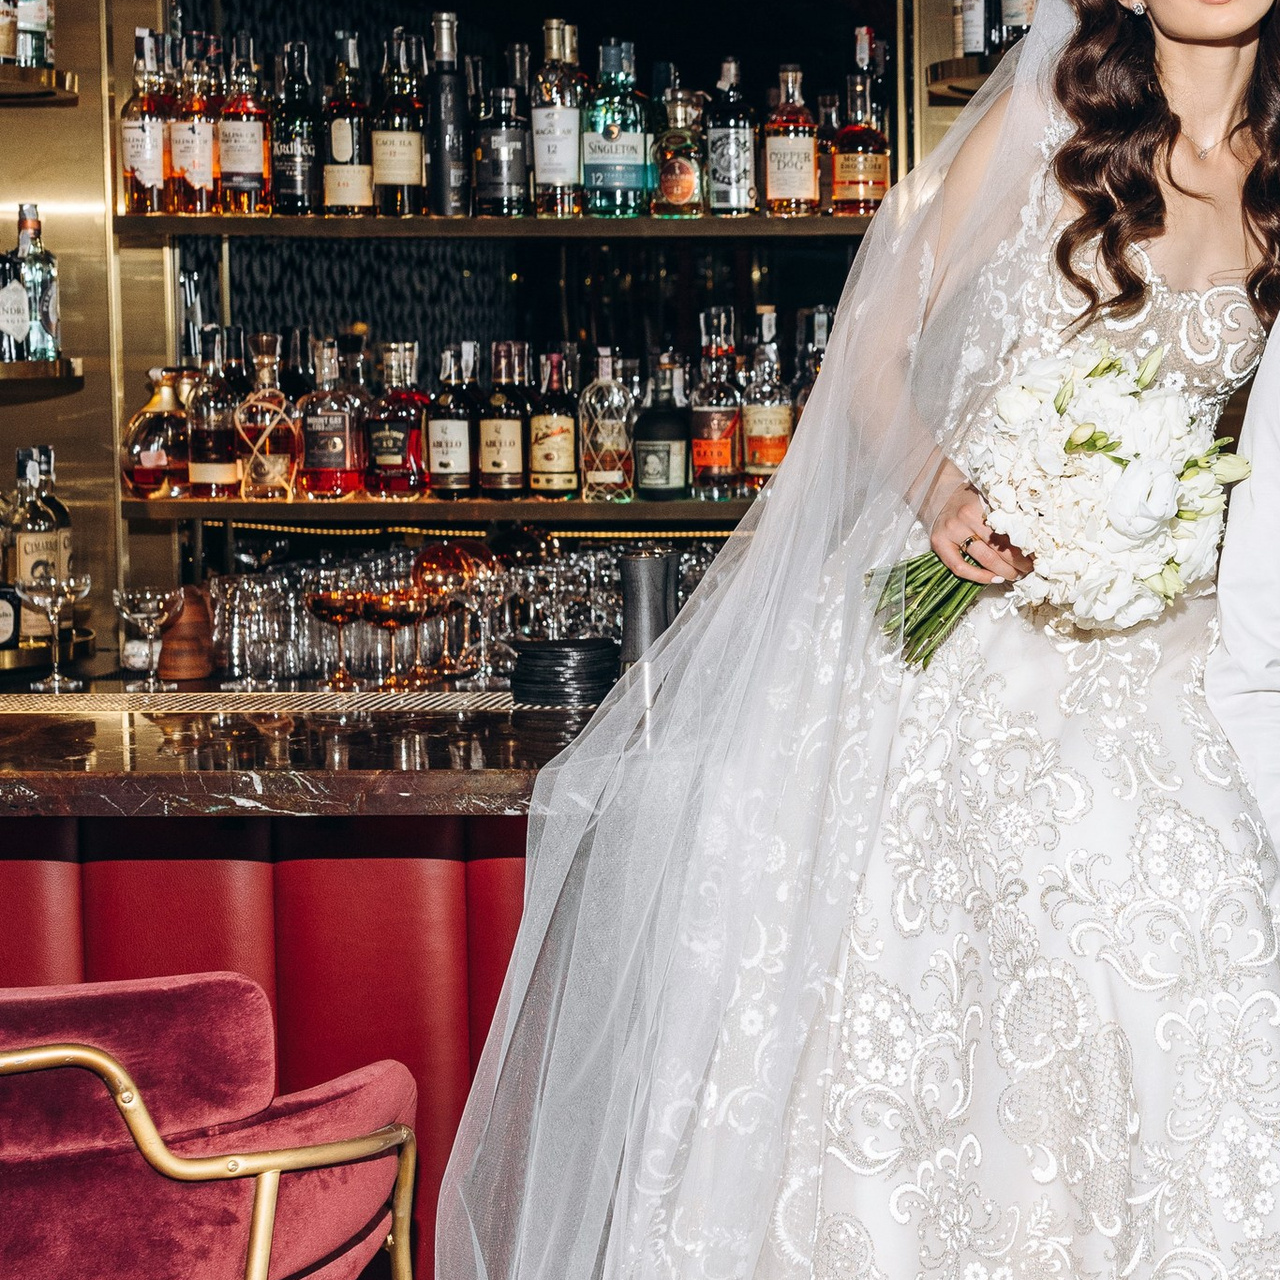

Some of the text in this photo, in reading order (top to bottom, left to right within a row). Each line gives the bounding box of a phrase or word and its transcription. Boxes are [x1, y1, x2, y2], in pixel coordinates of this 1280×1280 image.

[273, 141, 315, 157] Ardbeg
[547, 144, 557, 154] 12
[588, 142, 638, 155] SINGLETON
[769, 151, 811, 162] COPPER
[777, 160, 803, 170] DOG
[591, 172, 604, 186] 12
